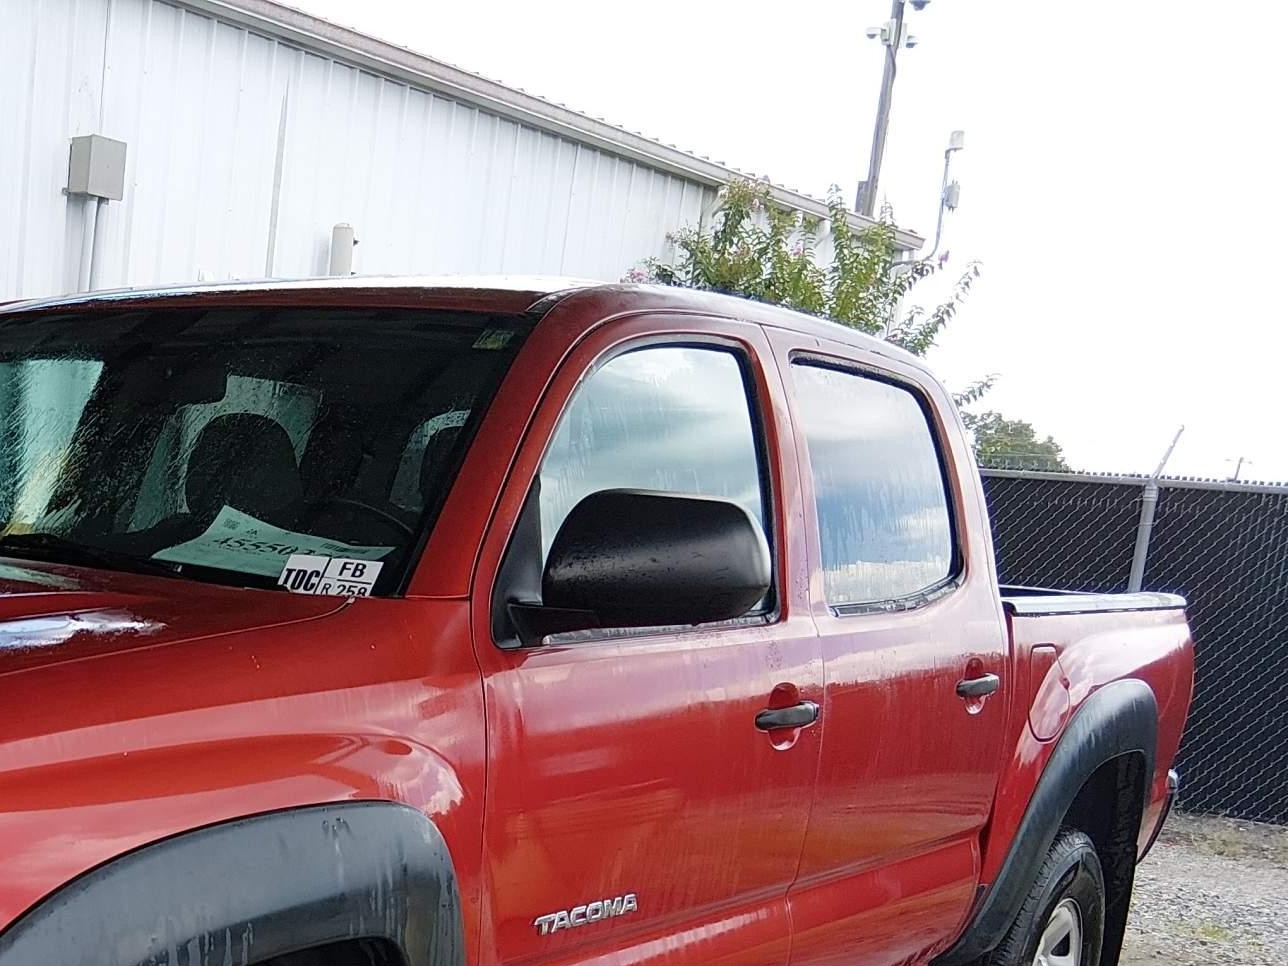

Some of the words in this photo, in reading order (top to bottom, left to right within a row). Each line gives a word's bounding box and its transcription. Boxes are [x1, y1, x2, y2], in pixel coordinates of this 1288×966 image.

[337, 561, 367, 578] FB
[320, 582, 332, 595] R
[534, 893, 638, 935] TACOMA
